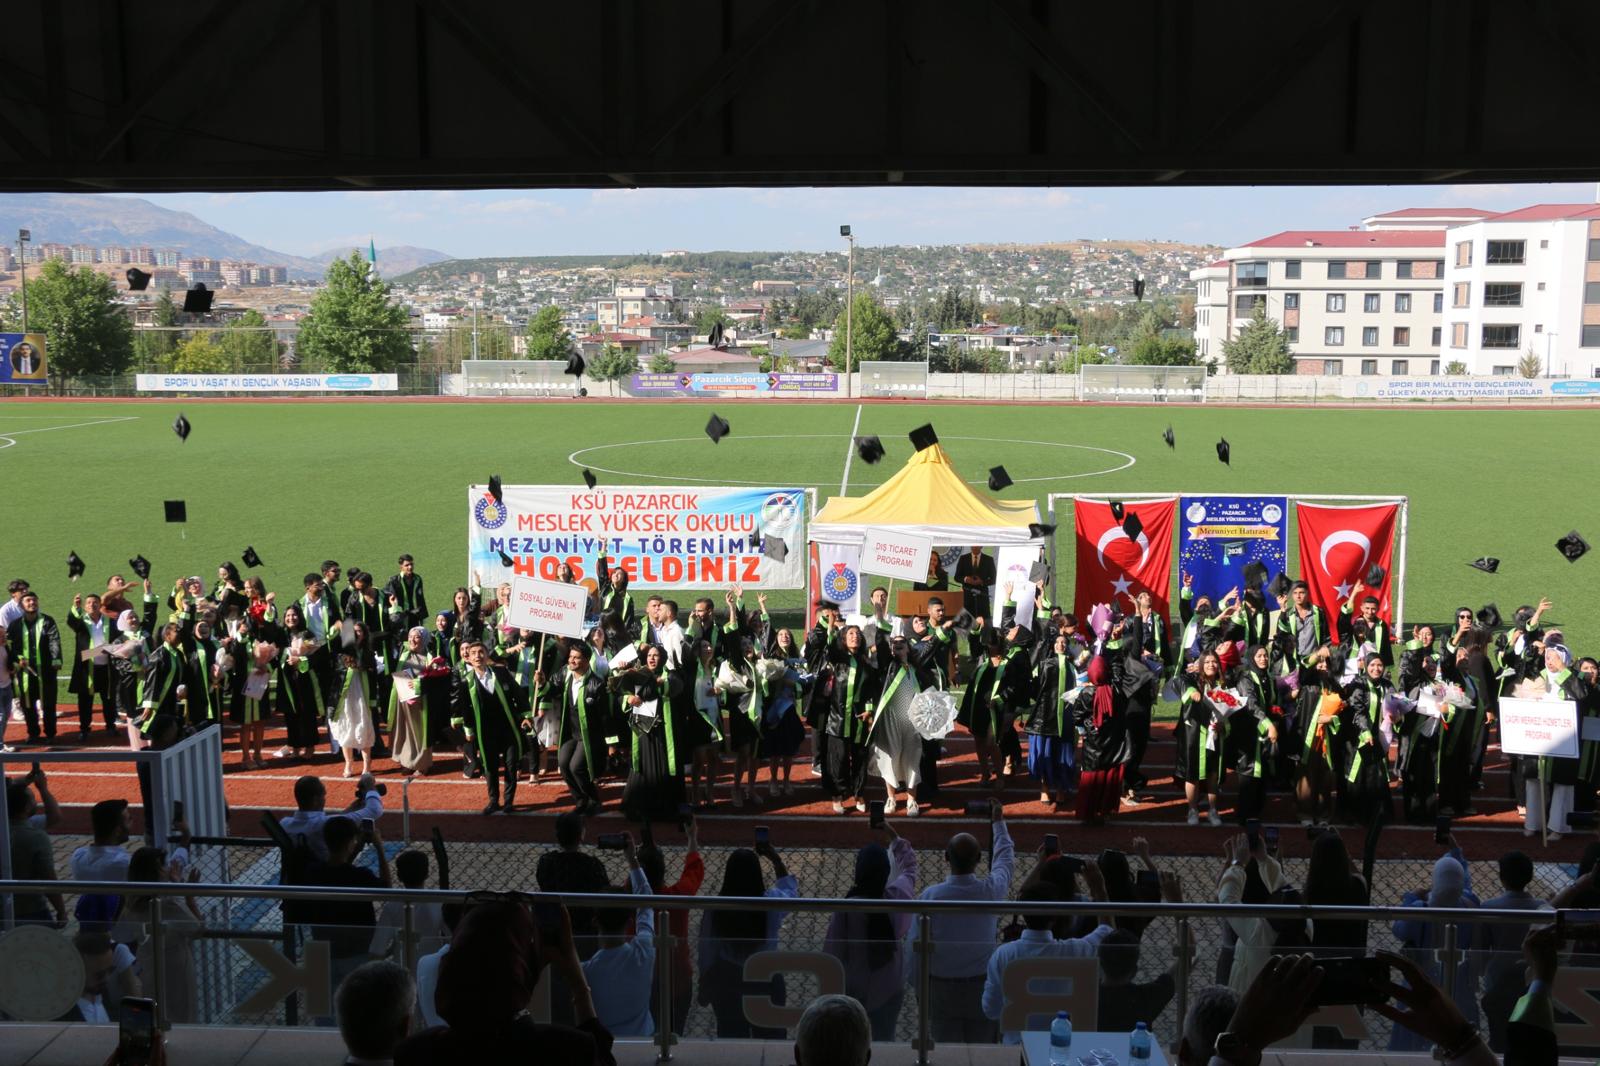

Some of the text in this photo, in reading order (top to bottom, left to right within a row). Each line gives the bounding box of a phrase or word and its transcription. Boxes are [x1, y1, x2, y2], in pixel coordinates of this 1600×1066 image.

[200, 378, 228, 389] YAŞAT
[243, 376, 279, 389] GENÇLİK
[282, 378, 321, 390] YAŞASIN
[571, 491, 699, 511] KSÜ PAZARCIK
[518, 510, 754, 532] MESLEK YÜKSEK OKULU
[1199, 527, 1237, 536] Mezuniyet
[889, 543, 918, 556] TİCARET
[876, 554, 913, 568] PROGRAMI
[519, 592, 544, 605] SOSYAL
[529, 607, 563, 621] PROGRAMI
